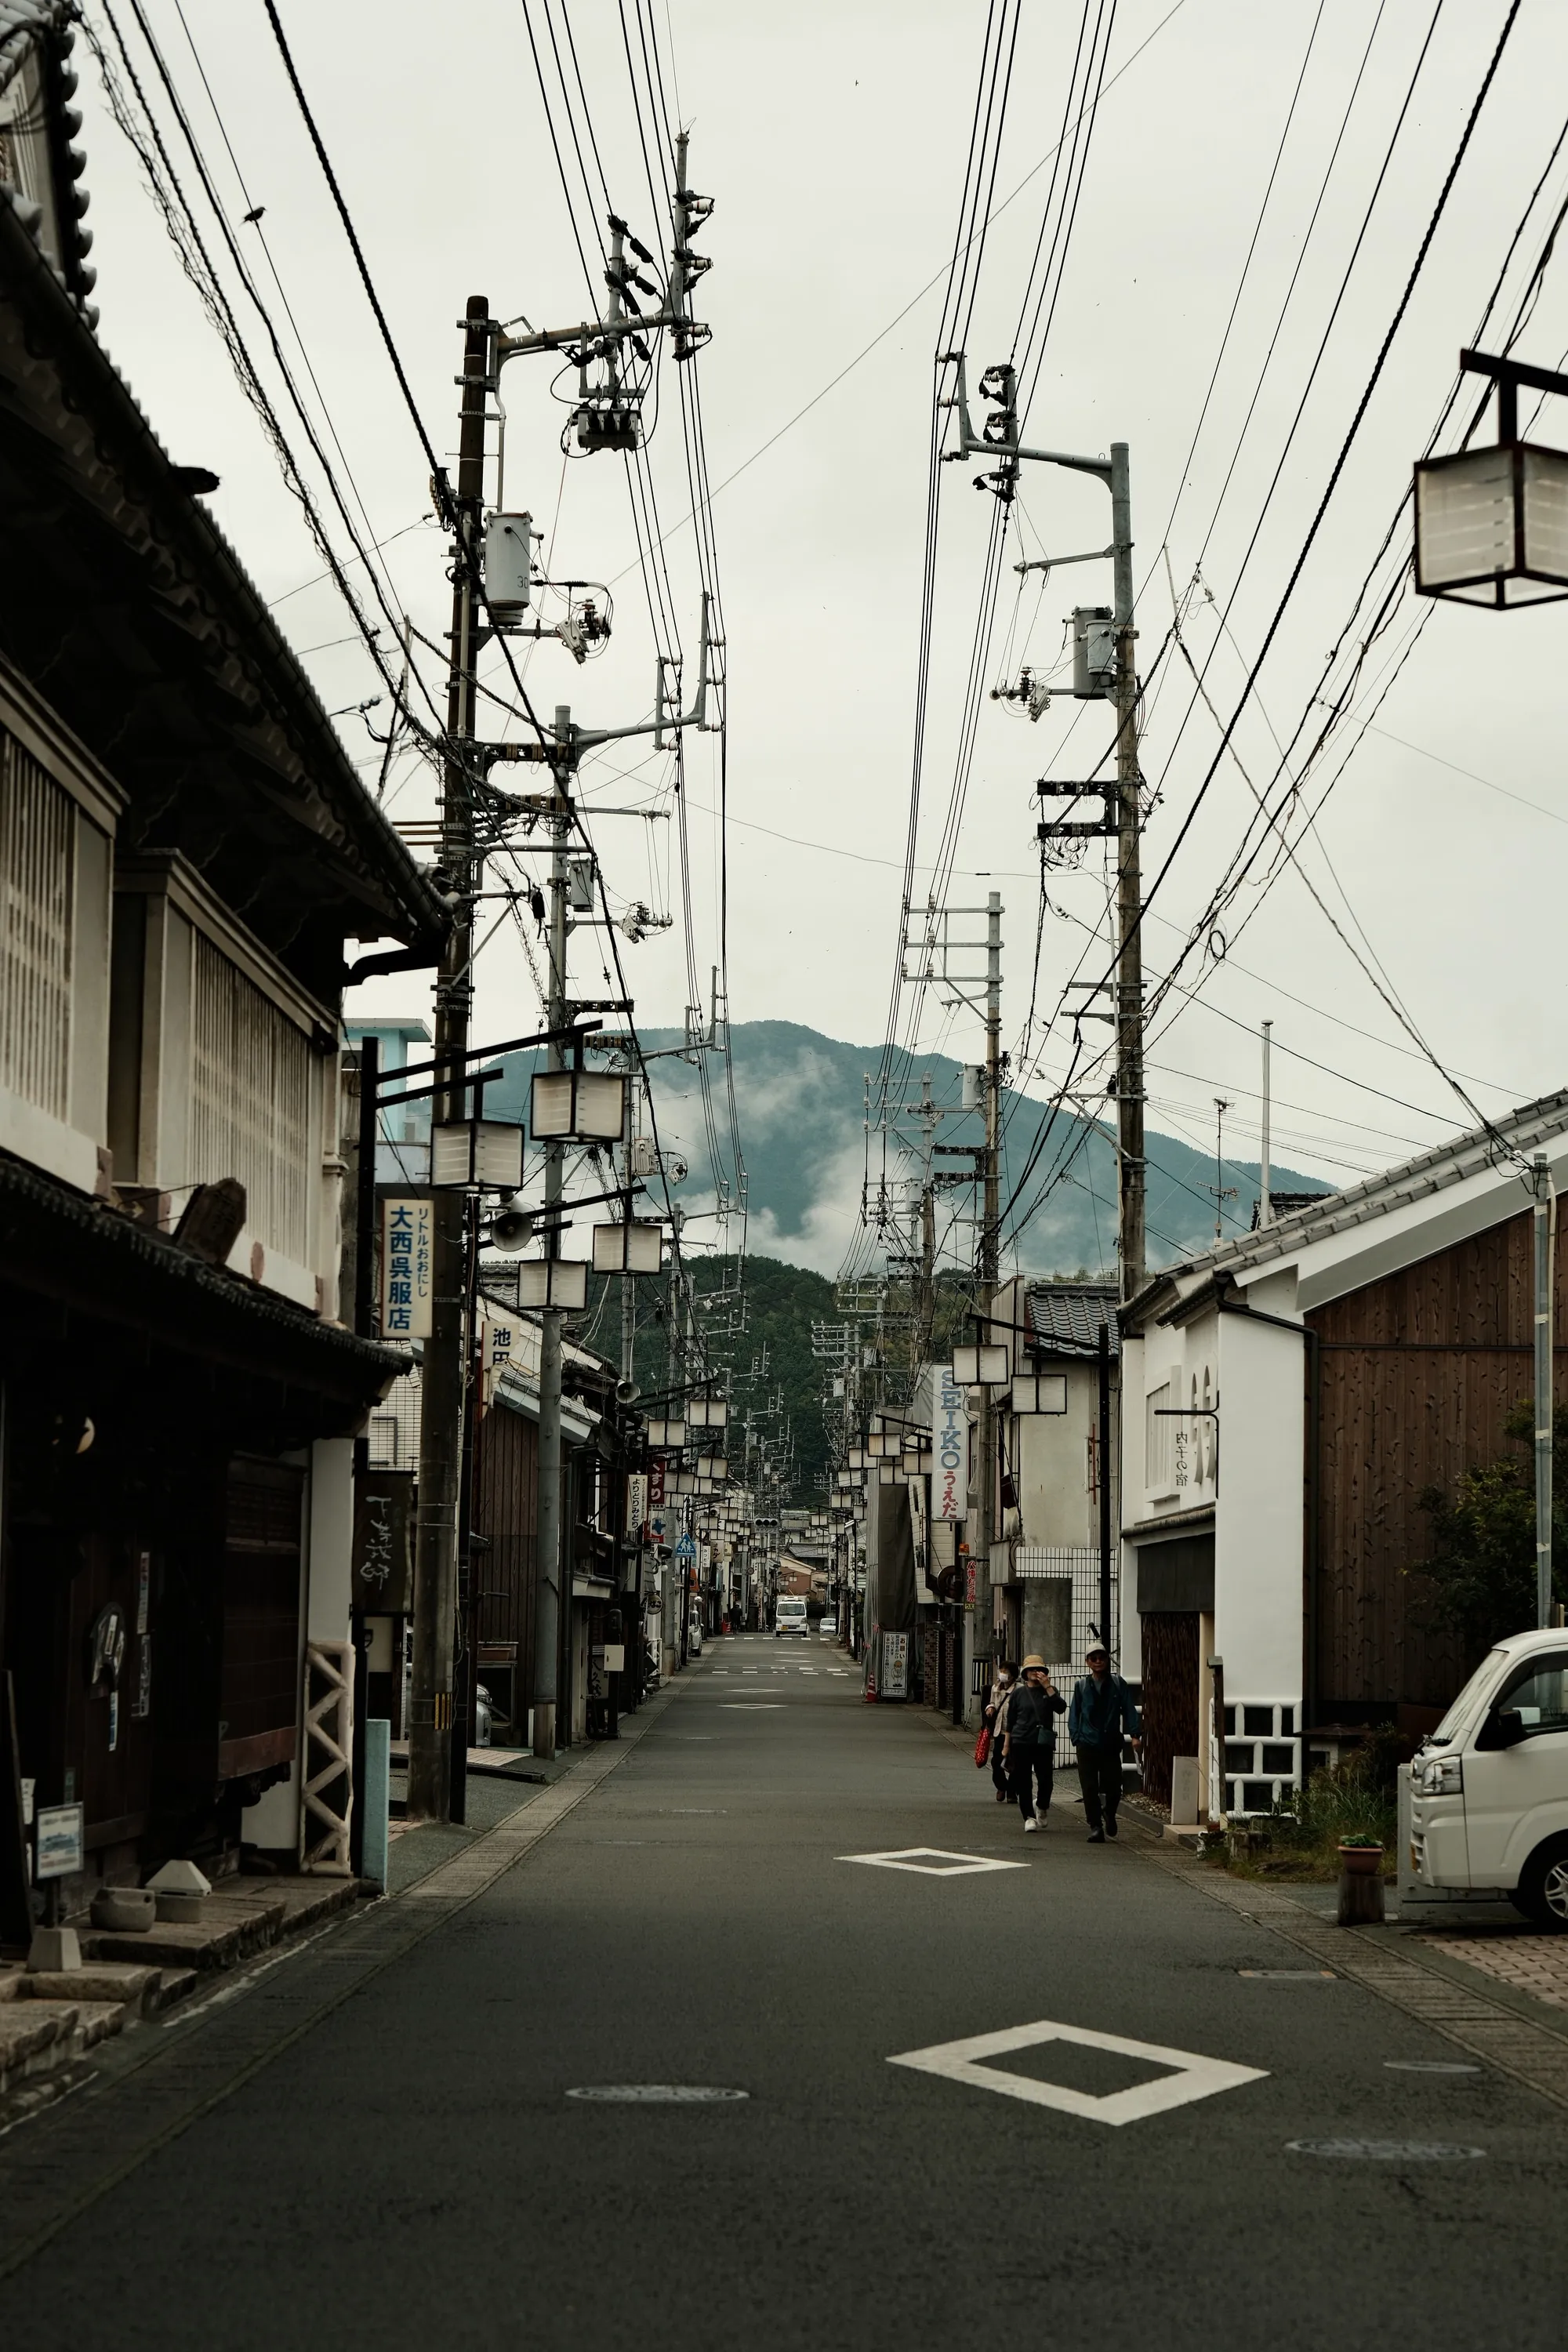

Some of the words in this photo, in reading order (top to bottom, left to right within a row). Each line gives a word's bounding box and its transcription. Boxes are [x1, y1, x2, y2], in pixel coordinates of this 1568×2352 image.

[388, 1205, 413, 1330] 大西呉服店
[416, 1207, 429, 1298] リトルおおにし
[940, 1368, 961, 1469] SEIKO
[631, 1478, 641, 1529] よりどりみどり
[942, 1471, 959, 1519] うえだ
